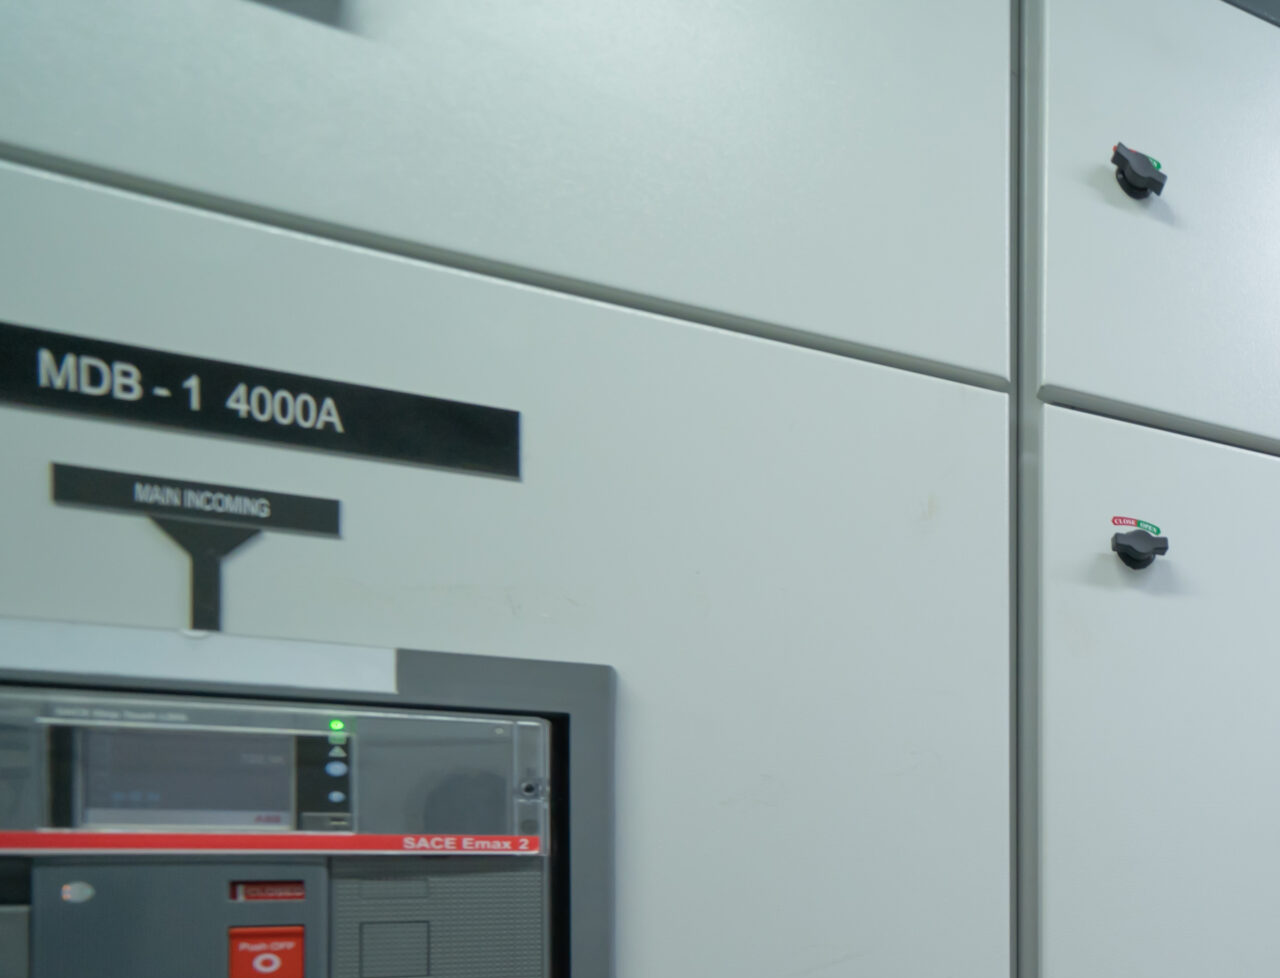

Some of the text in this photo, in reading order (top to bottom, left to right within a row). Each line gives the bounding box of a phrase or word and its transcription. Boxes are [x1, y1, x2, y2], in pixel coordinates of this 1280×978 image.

[37, 348, 143, 400] MDB
[182, 374, 201, 411] 1
[225, 383, 345, 433] 4000A
[134, 481, 272, 518] MAIN INCOMING
[403, 836, 530, 850] SACE Emax 2
